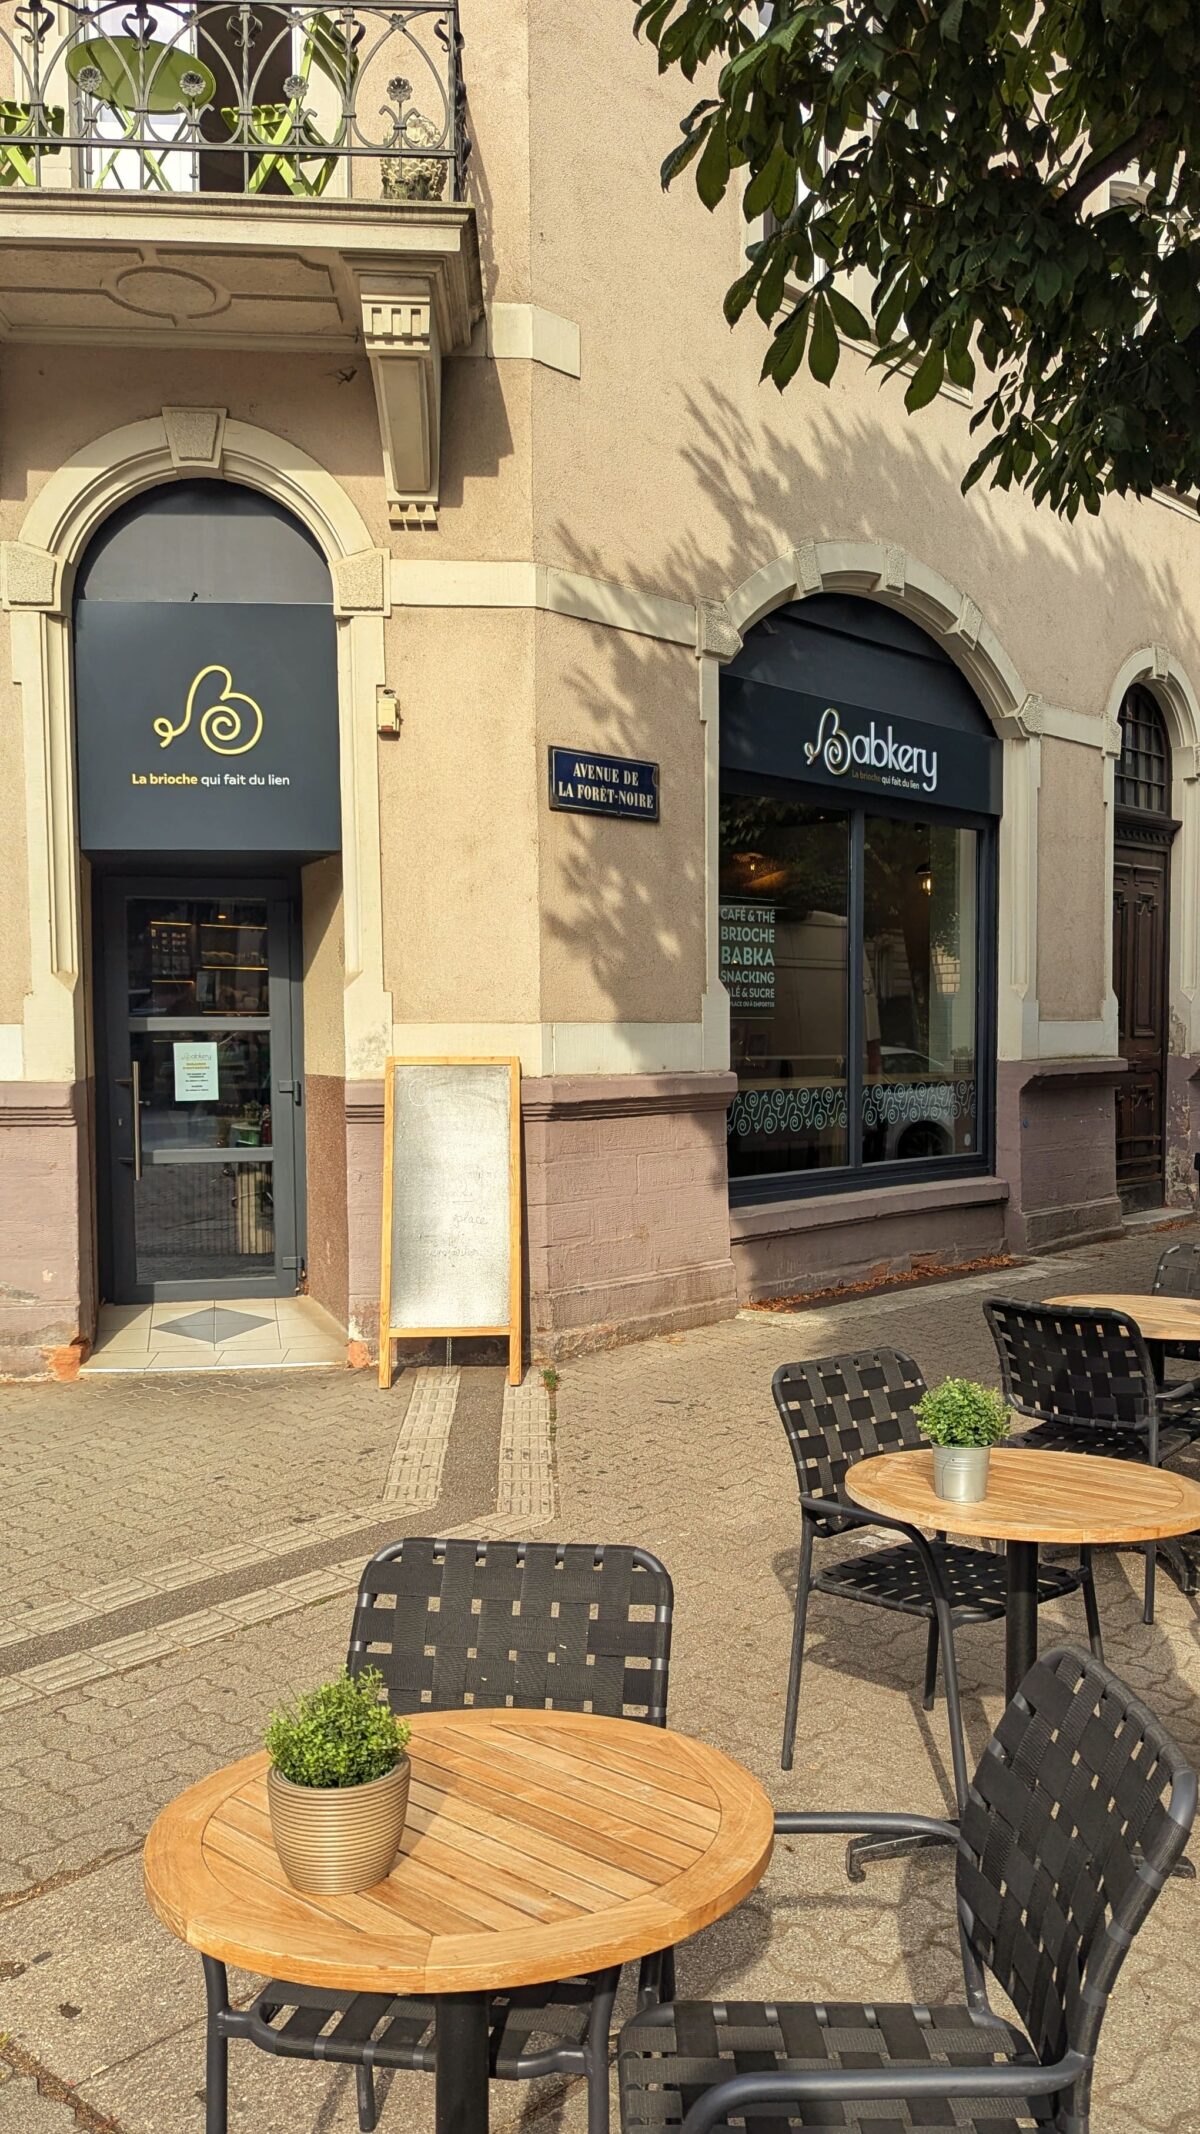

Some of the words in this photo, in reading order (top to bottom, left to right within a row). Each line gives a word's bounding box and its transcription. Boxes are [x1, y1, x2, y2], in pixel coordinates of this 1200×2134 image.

[804, 708, 938, 793] Babkery
[131, 773, 148, 785] La
[149, 773, 199, 785] brioche
[200, 774, 222, 788] qui
[223, 774, 247, 786] fait
[248, 774, 266, 786] du
[268, 774, 291, 786] lien
[573, 762, 620, 784] AVENUE
[623, 770, 639, 787] DE
[881, 776, 891, 786] qui
[891, 776, 902, 787] fait
[902, 778, 910, 788] du
[909, 779, 920, 790] lien
[558, 781, 574, 798] LA
[577, 784, 654, 809] FORÊT-NOIRE
[720, 907, 746, 922] CAFÉ
[747, 910, 756, 922] &
[756, 909, 776, 924] THÉ
[720, 926, 776, 943] BRIOCHE
[721, 946, 776, 967] BABKA
[720, 970, 776, 984] SNACKING
[727, 985, 741, 998] LÉ
[741, 987, 749, 998] &
